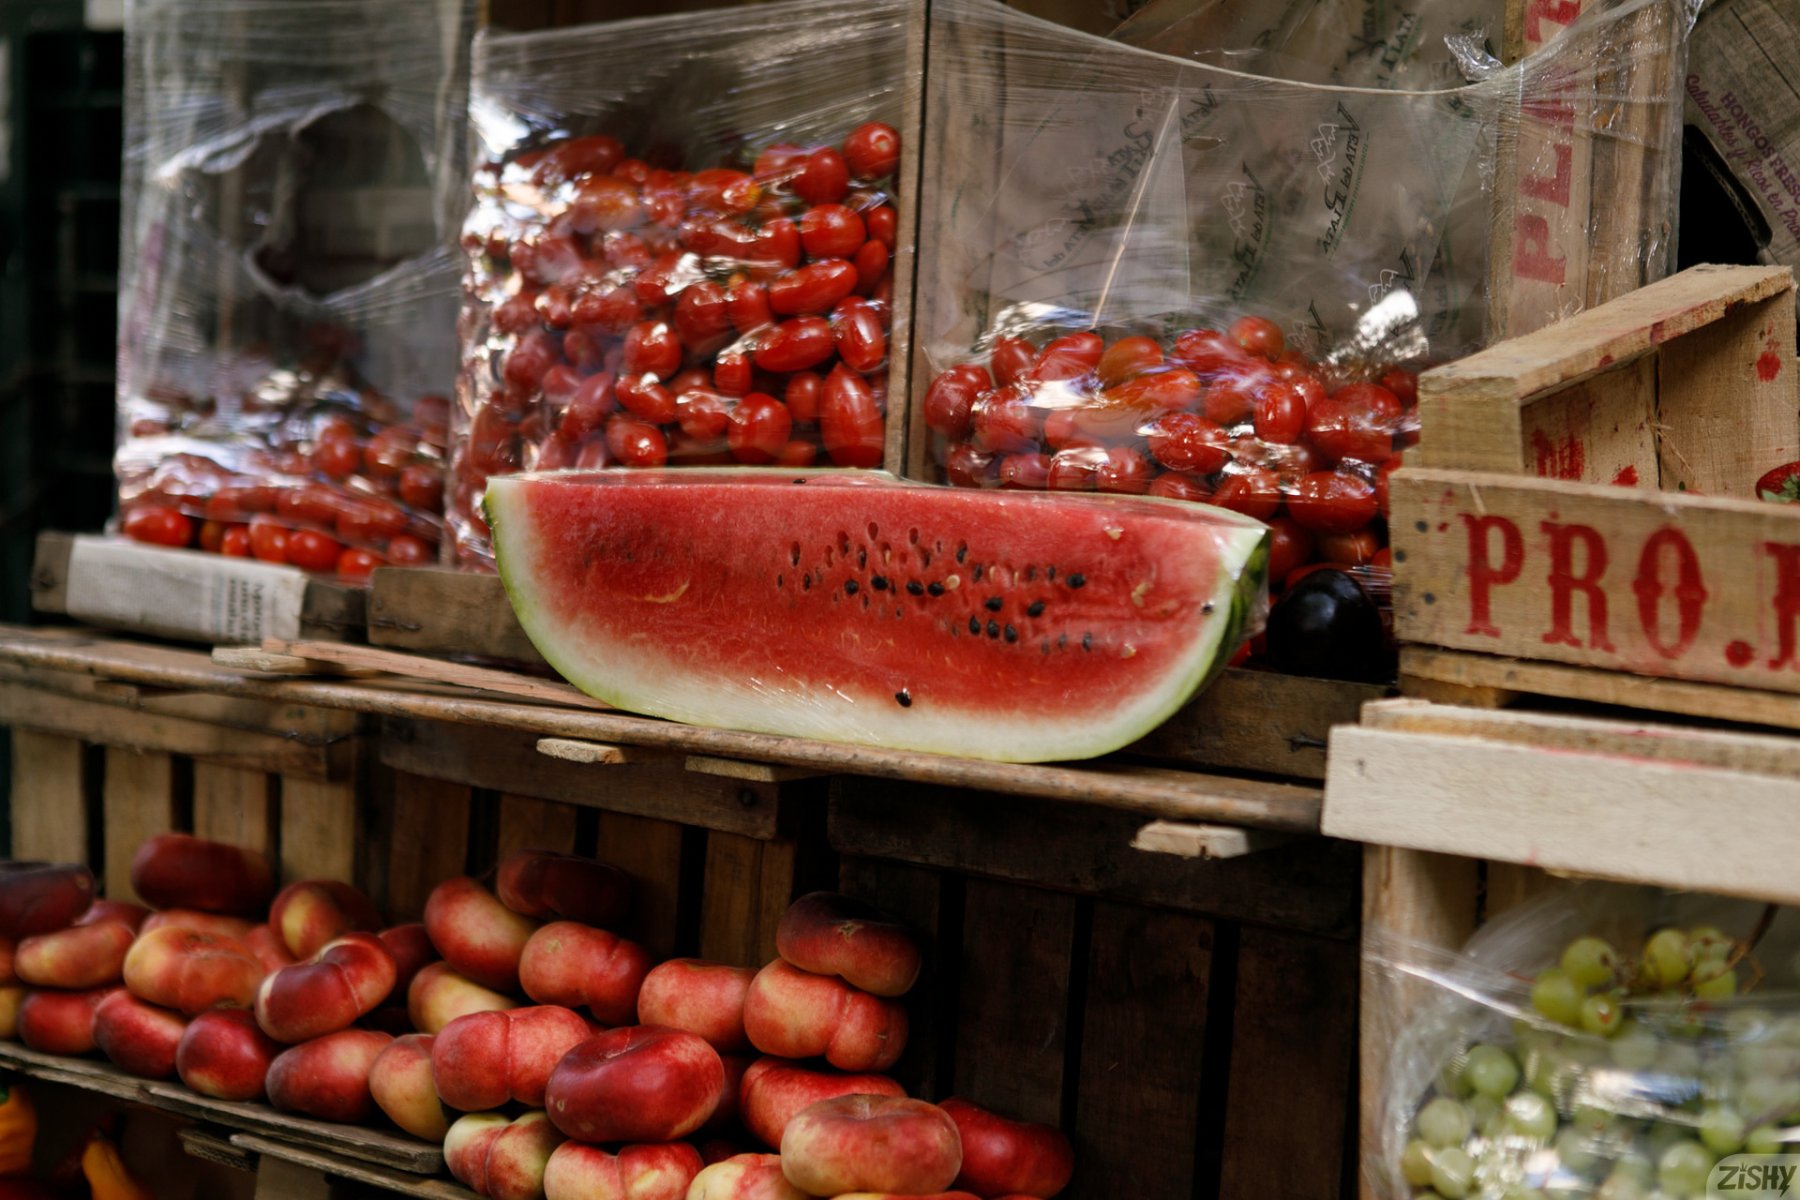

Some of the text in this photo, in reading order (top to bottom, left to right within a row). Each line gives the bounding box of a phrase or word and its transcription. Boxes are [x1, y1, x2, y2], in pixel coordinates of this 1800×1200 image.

[1684, 74, 1738, 147] Saludables
[1726, 147, 1746, 160] y
[1743, 156, 1773, 194] Ricos
[1767, 192, 1783, 211] en
[1720, 91, 1779, 159] HONGOS
